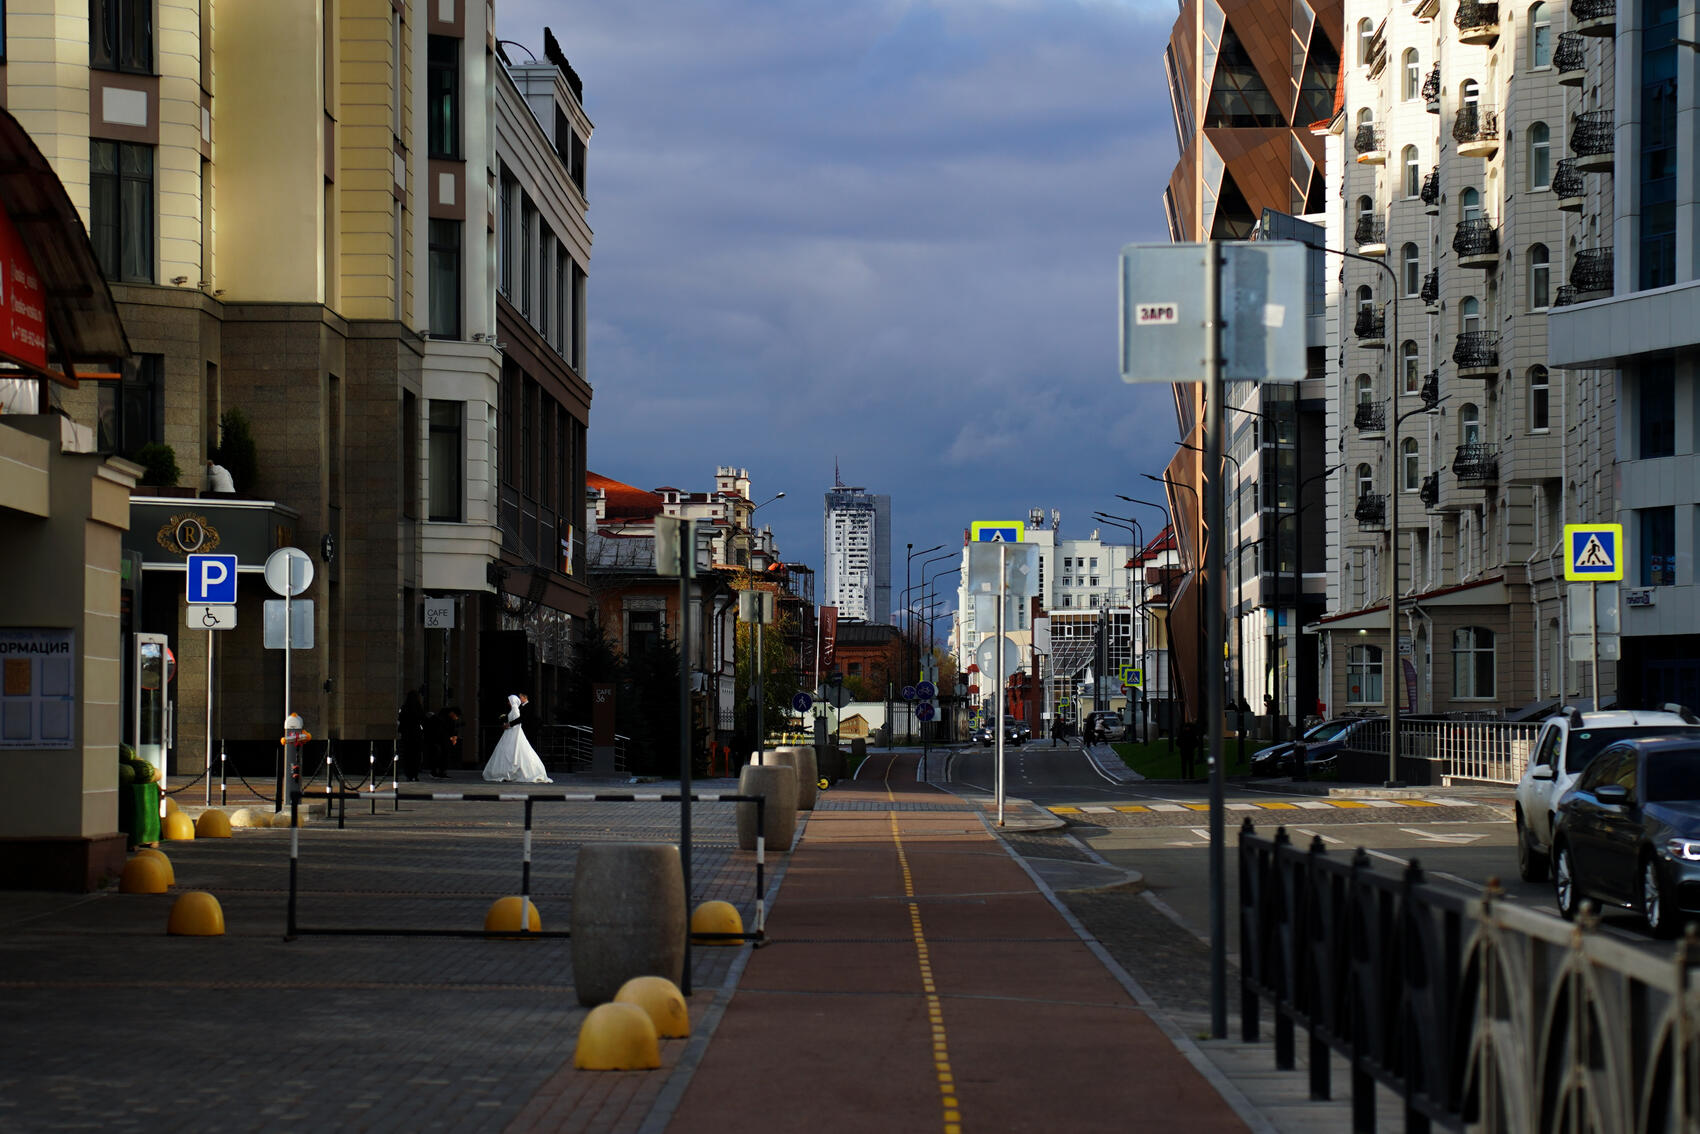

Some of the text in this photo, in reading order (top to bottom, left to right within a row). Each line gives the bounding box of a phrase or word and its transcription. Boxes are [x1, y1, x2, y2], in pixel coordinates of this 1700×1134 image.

[184, 526, 196, 543] R
[201, 560, 228, 597] P
[427, 617, 439, 626] 36
